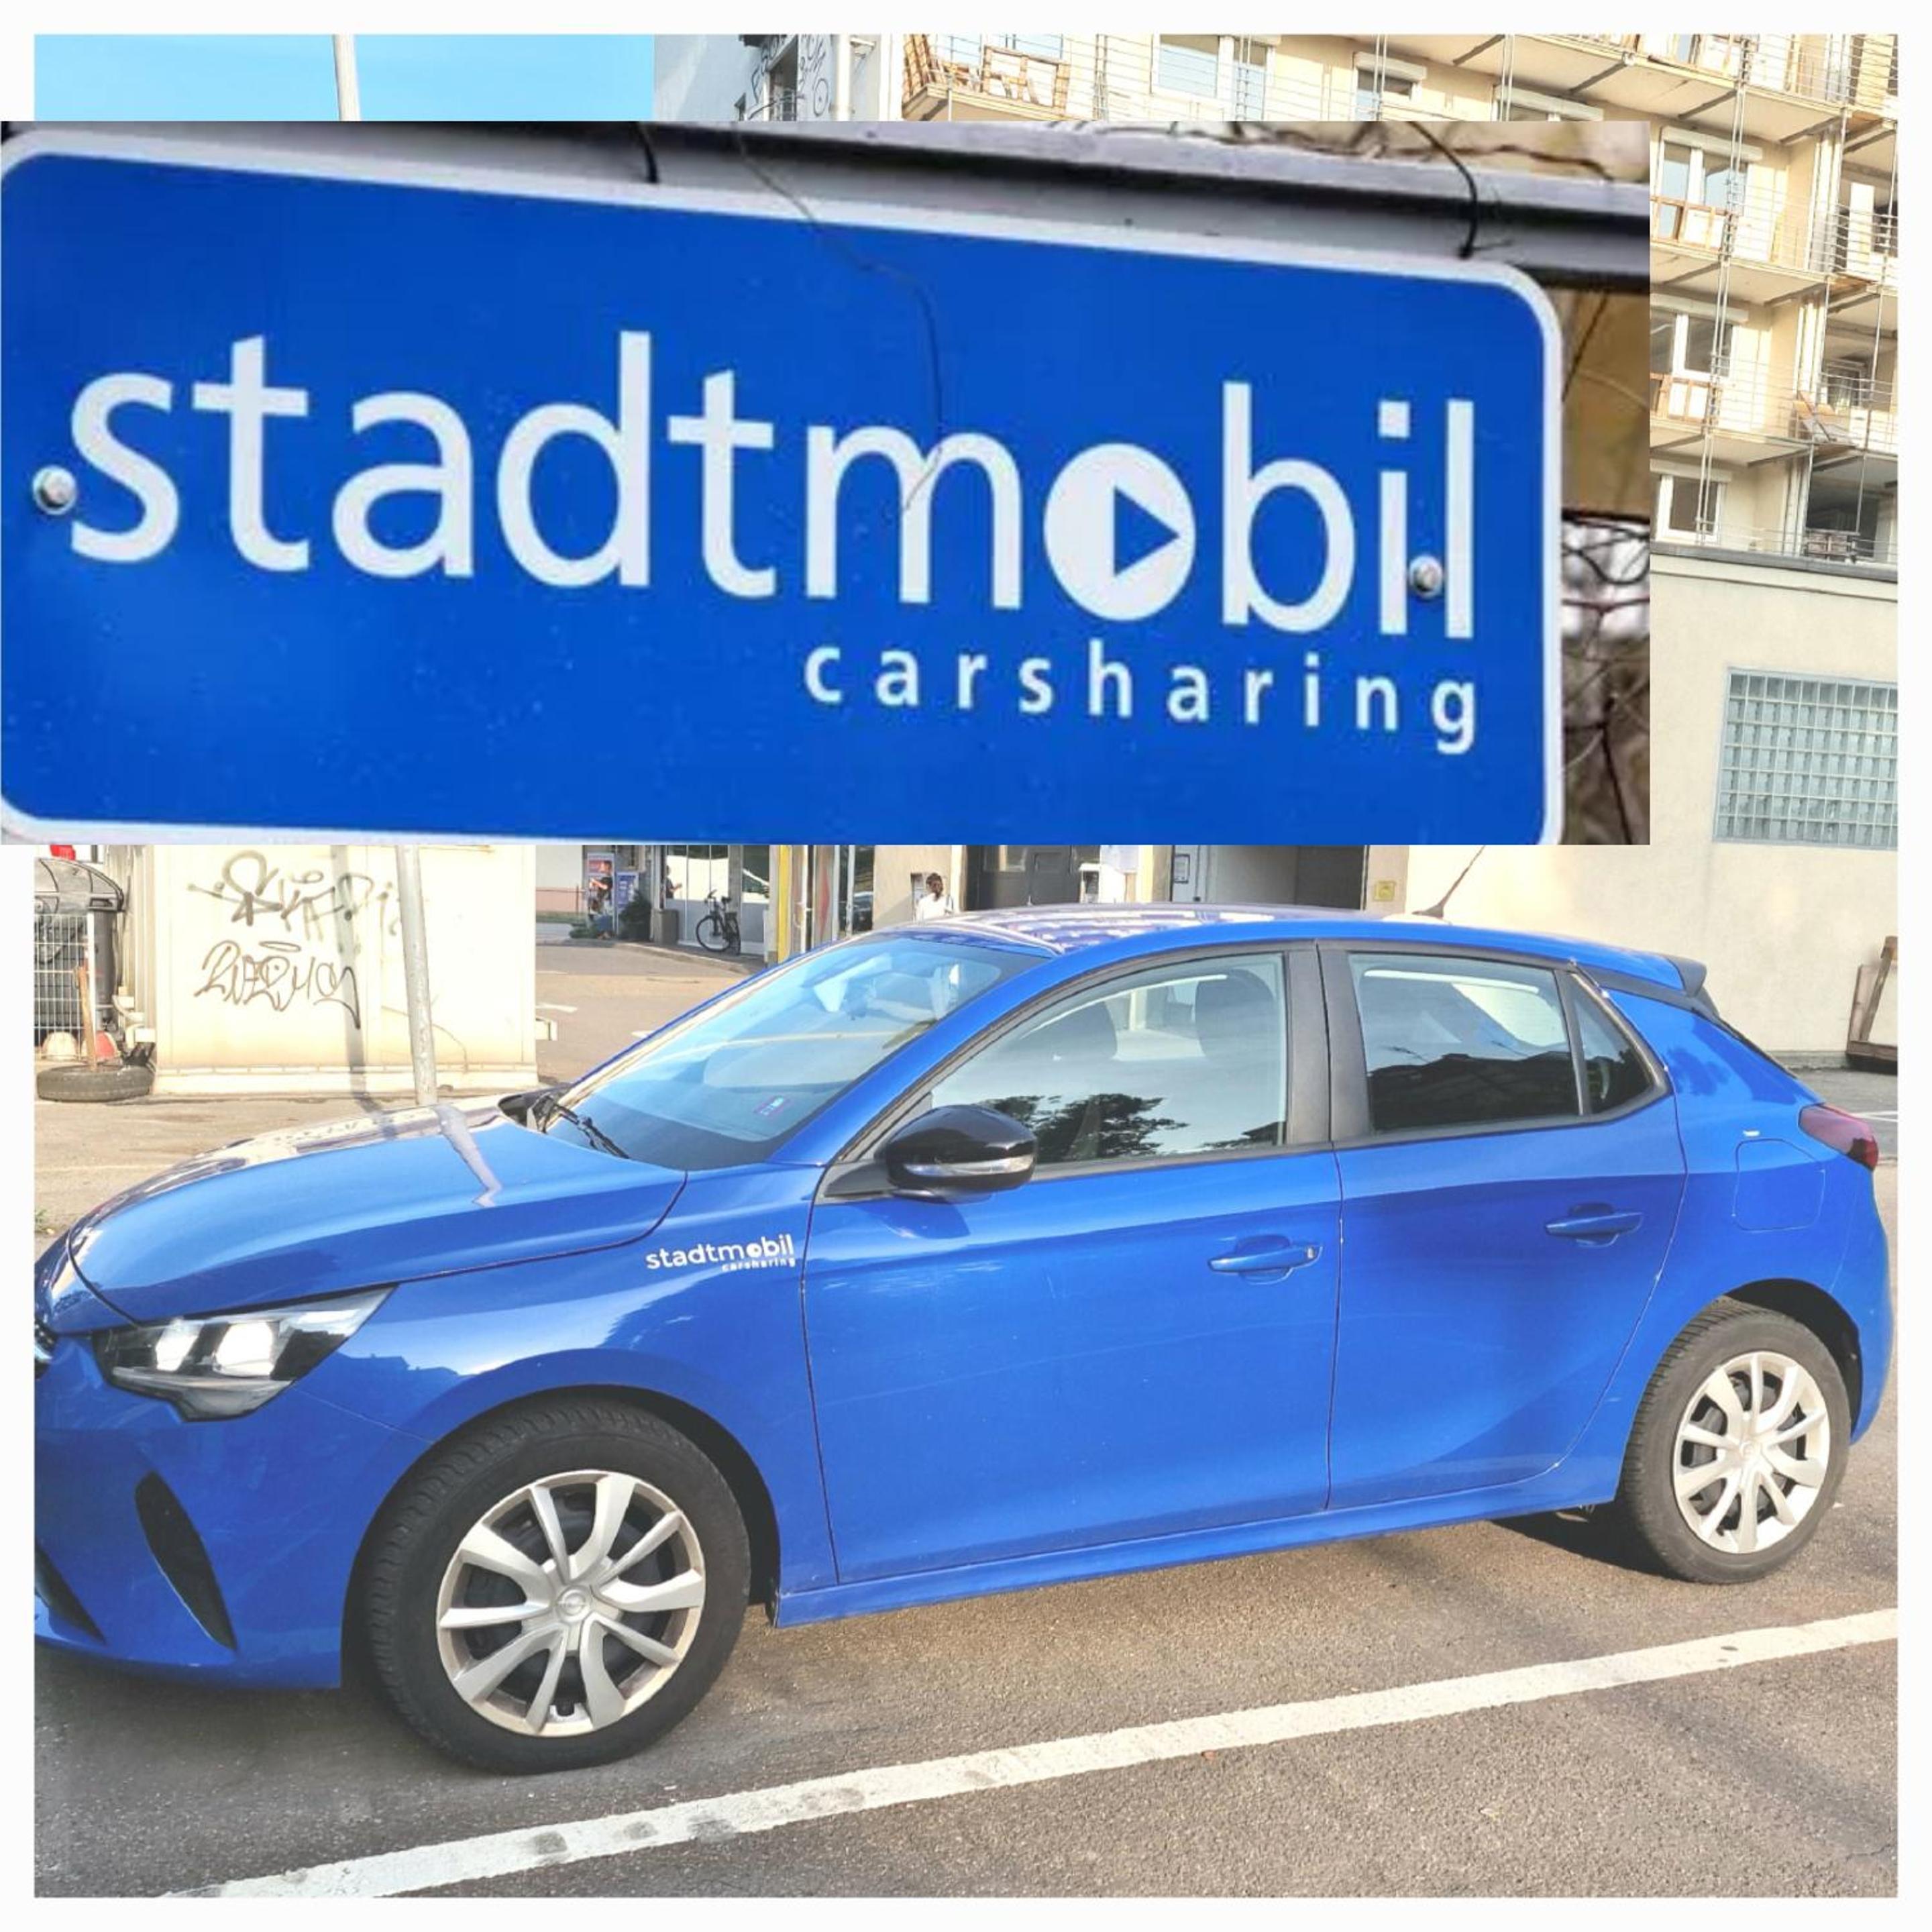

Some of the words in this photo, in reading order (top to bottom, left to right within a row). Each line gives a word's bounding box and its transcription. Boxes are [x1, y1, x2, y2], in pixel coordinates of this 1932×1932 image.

[70, 330, 1474, 639] stadtmobil
[804, 639, 1476, 755] carsharing
[645, 1234, 794, 1269] stadtmobil
[721, 1256, 796, 1272] carsharing
